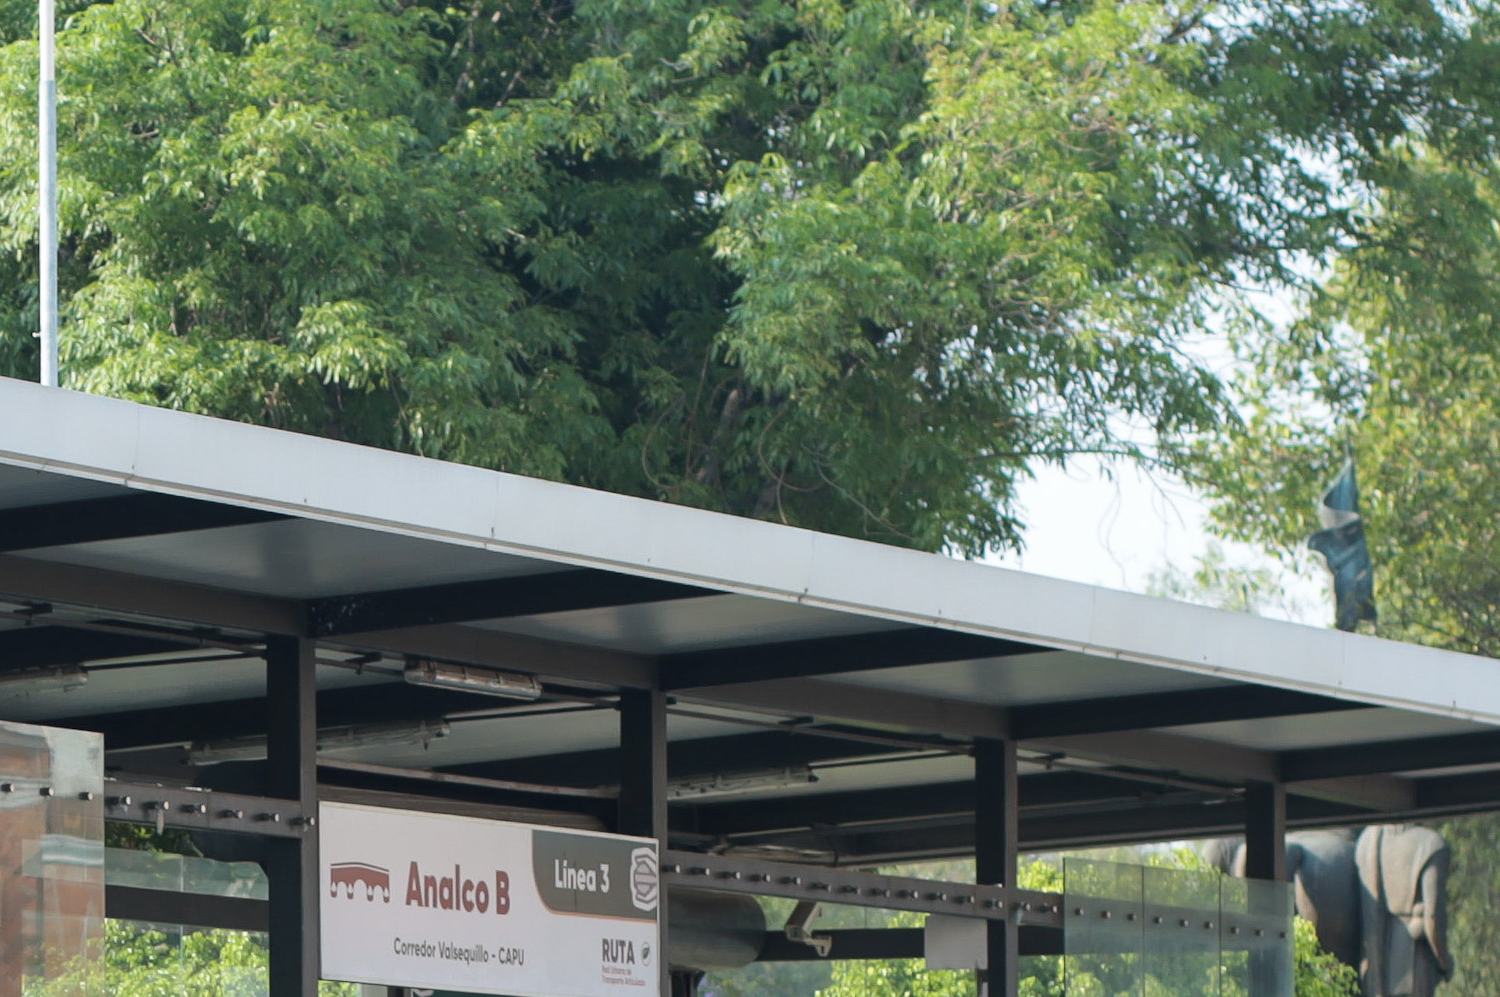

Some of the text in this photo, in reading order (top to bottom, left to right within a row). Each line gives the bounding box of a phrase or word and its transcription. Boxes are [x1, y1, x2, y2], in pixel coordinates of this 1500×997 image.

[405, 860, 510, 915] Analco B
[554, 858, 610, 893] Línea 3
[394, 937, 436, 958] Corredor
[438, 941, 489, 965] Valsequillo
[498, 947, 525, 966] CAPU
[602, 938, 635, 965] RUTA
